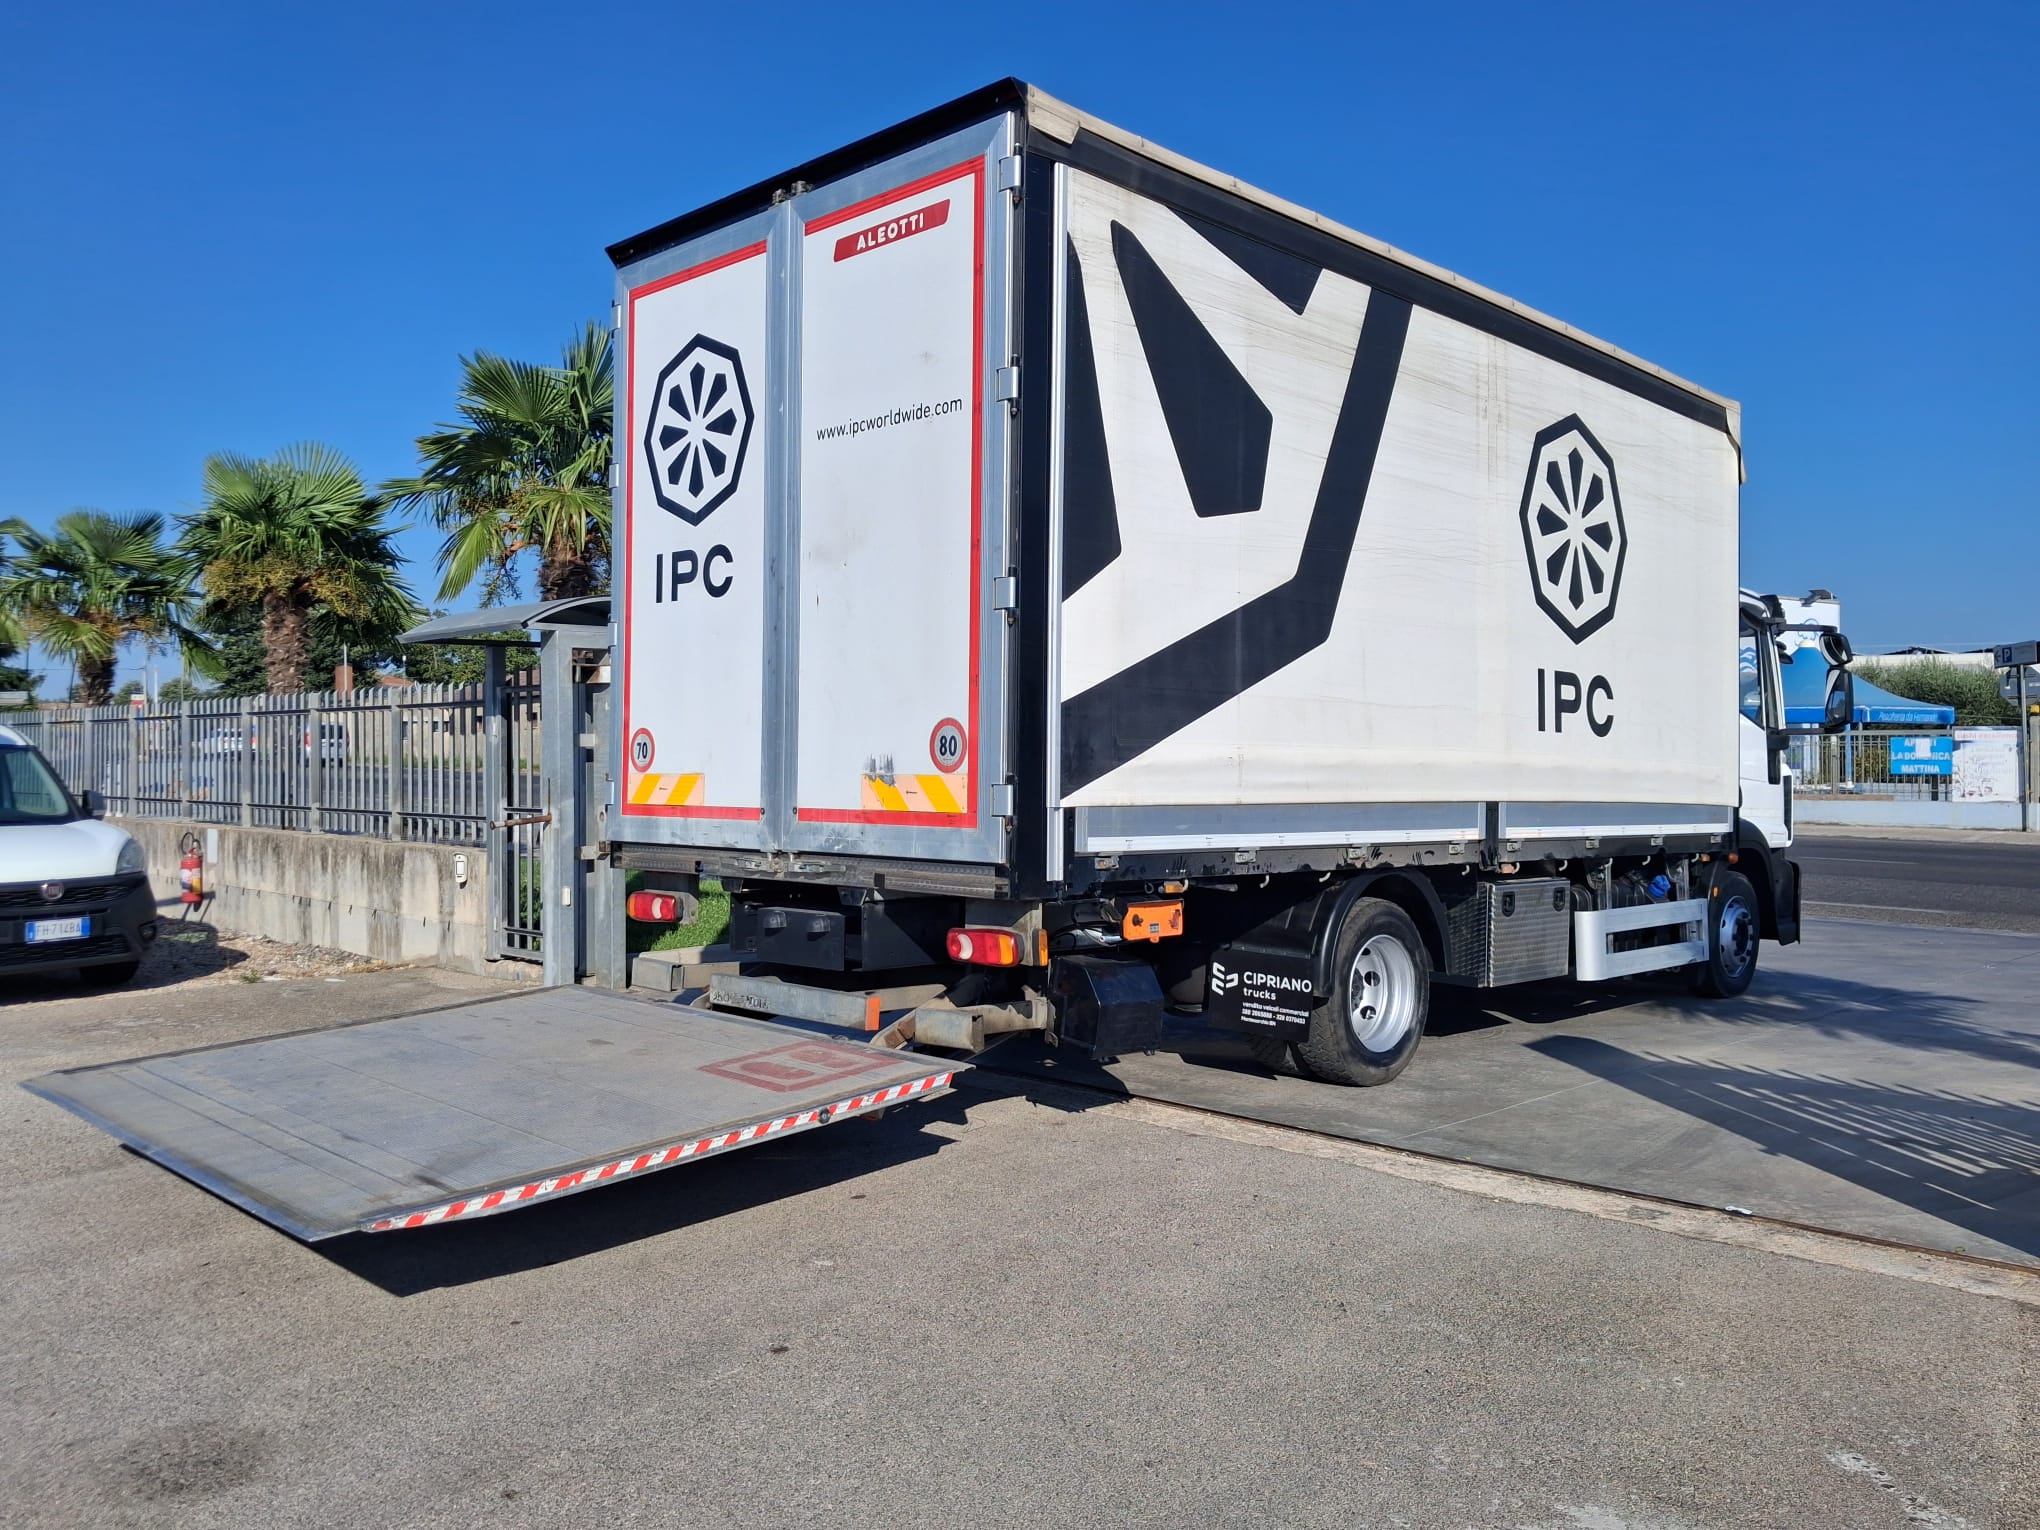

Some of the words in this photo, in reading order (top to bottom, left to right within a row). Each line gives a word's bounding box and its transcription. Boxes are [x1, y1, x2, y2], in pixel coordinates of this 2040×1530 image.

[857, 212, 924, 251] ALEOTTI
[816, 398, 963, 441] www.ipcworldwide.com
[656, 543, 734, 603] IPC
[1537, 667, 1614, 738] IPC
[636, 742, 648, 760] 70
[940, 735, 957, 756] 80
[1901, 764, 1940, 773] MATTINA
[1243, 971, 1312, 993] CIPRIANO
[1243, 987, 1276, 1000] trucks
